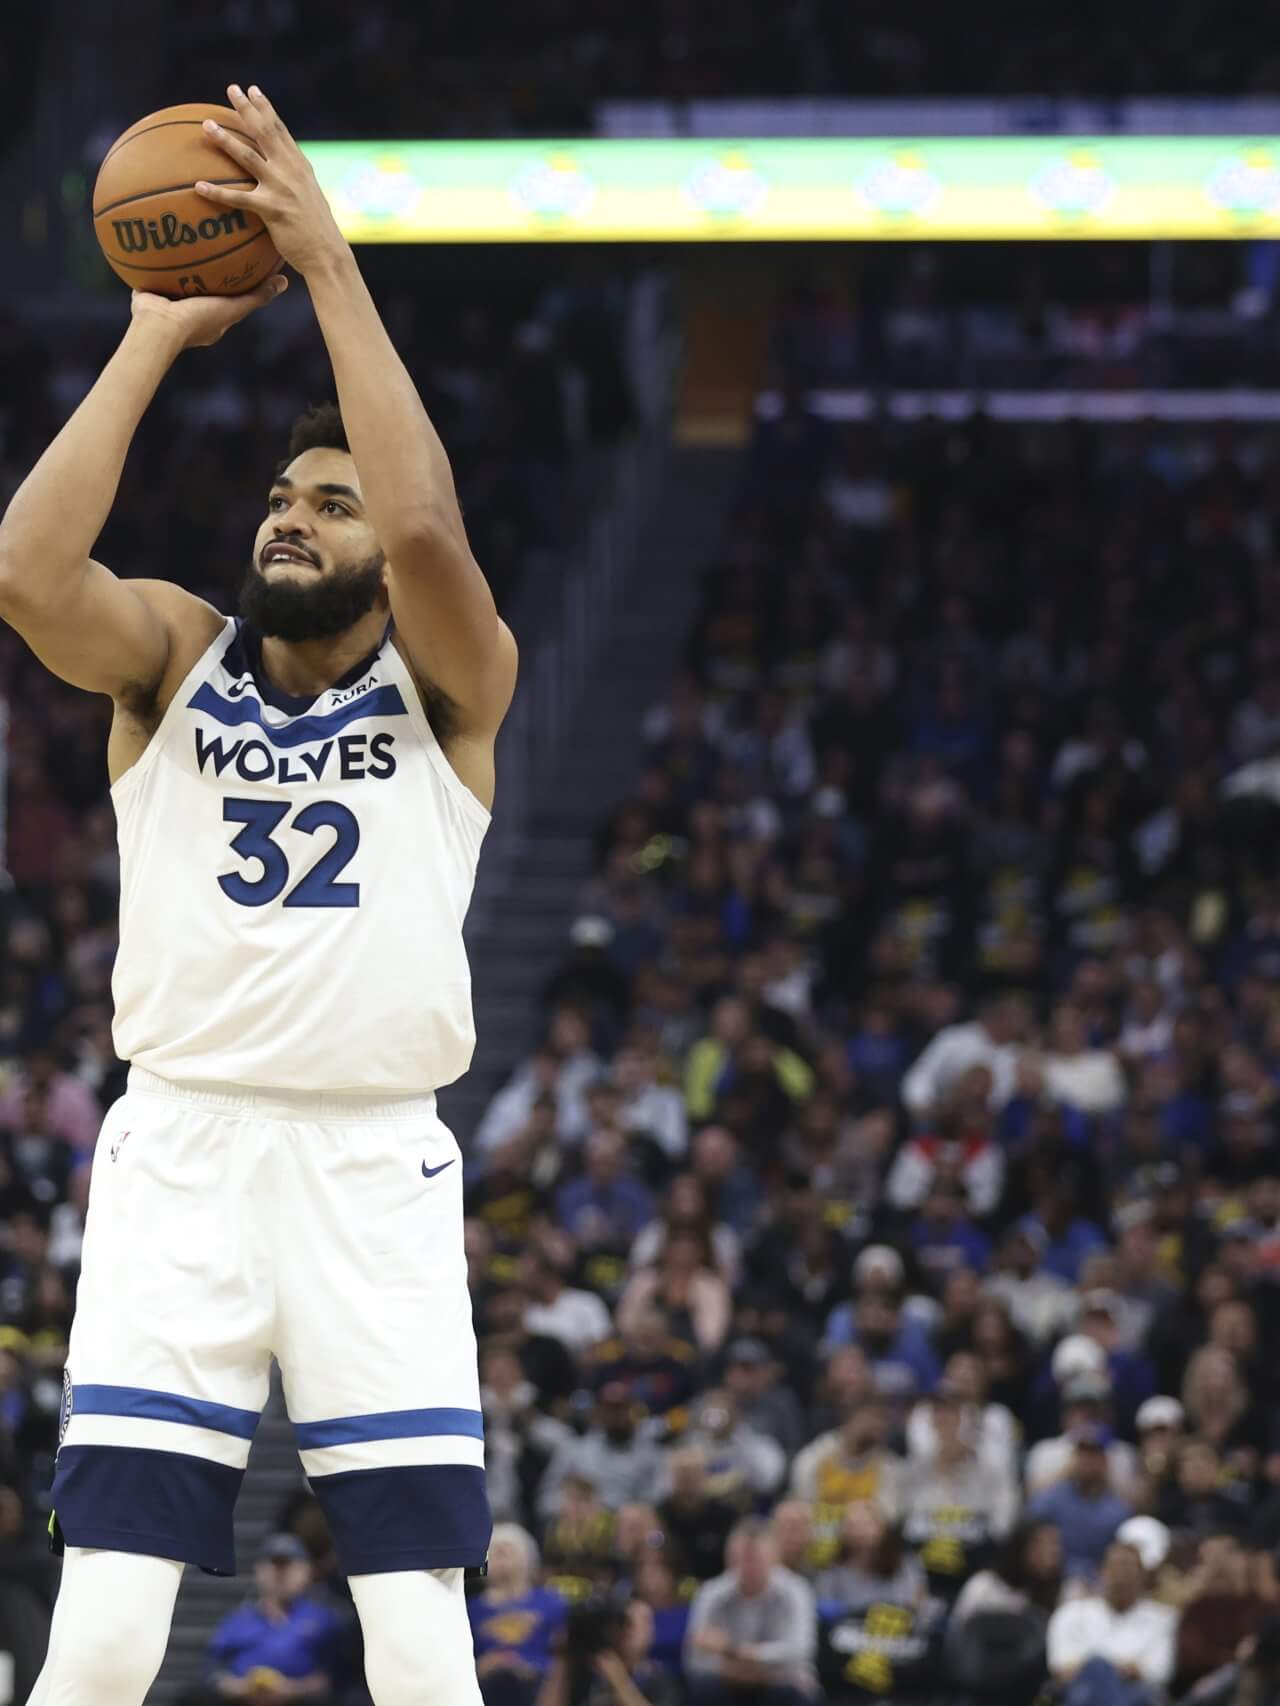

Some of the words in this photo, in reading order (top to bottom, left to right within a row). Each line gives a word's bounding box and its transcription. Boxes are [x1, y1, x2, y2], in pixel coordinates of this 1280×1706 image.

[112, 207, 248, 253] Wilson
[195, 728, 397, 784] WOLVES
[217, 797, 360, 908] 32
